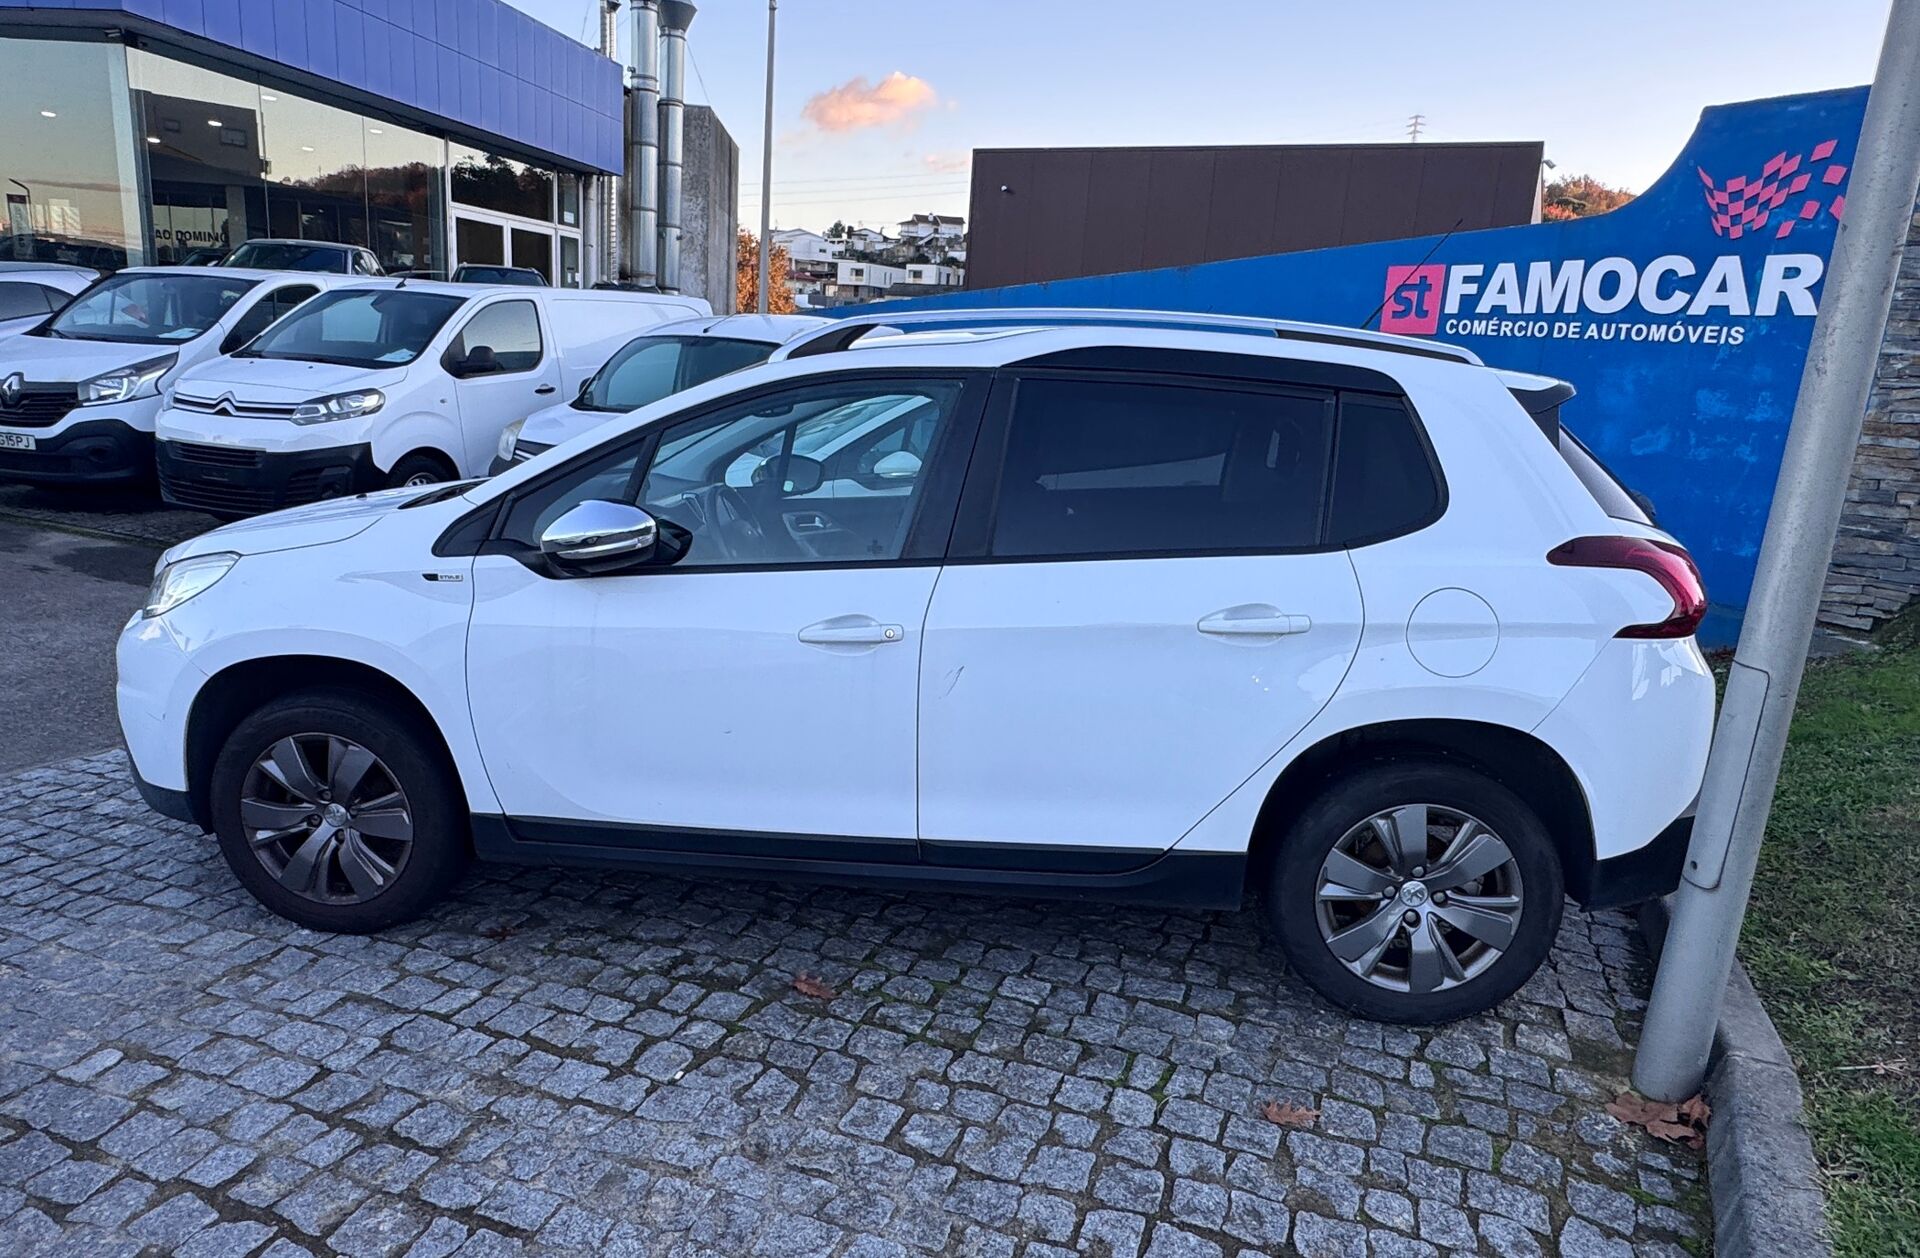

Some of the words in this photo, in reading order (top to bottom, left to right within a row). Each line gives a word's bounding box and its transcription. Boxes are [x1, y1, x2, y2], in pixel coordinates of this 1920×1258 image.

[1444, 253, 1824, 316] FAMOCAR
[1445, 317, 1549, 338] COMÉRCIO
[1553, 321, 1582, 339] DE
[1583, 320, 1745, 345] AUTOMÓVEIS
